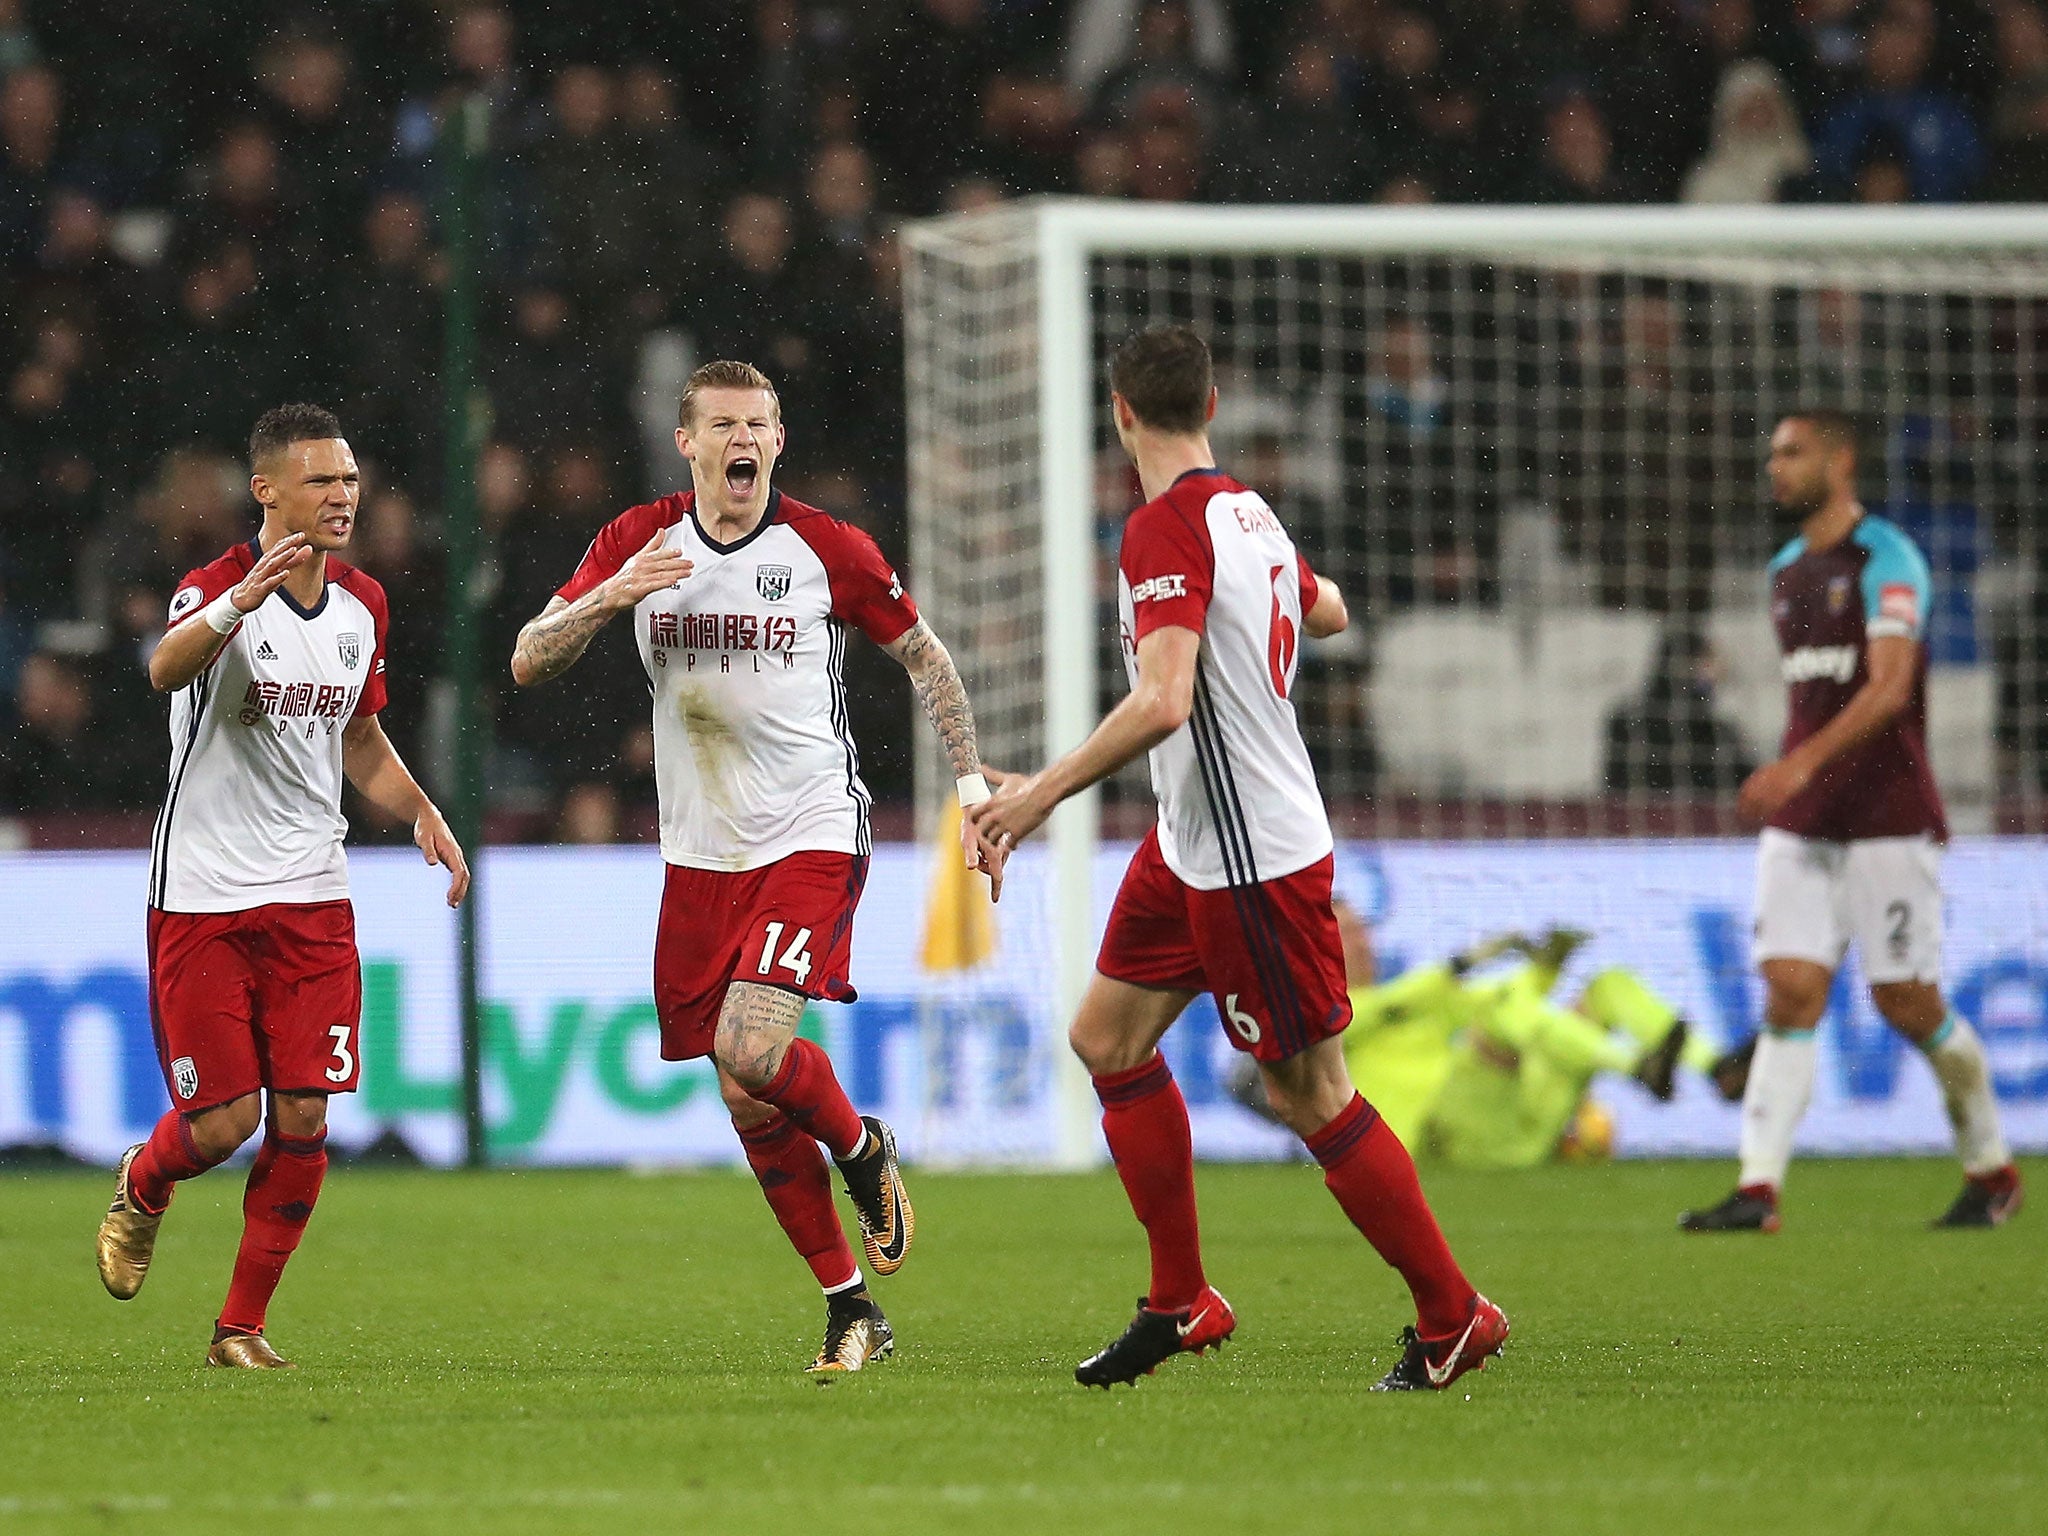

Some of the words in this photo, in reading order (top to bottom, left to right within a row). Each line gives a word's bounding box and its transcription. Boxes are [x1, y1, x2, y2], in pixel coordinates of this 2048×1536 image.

[1268, 564, 1295, 699] 6
[1886, 899, 1912, 944] 2
[757, 921, 812, 986] 14
[1226, 993, 1261, 1043] 6
[325, 1025, 354, 1083] 3
